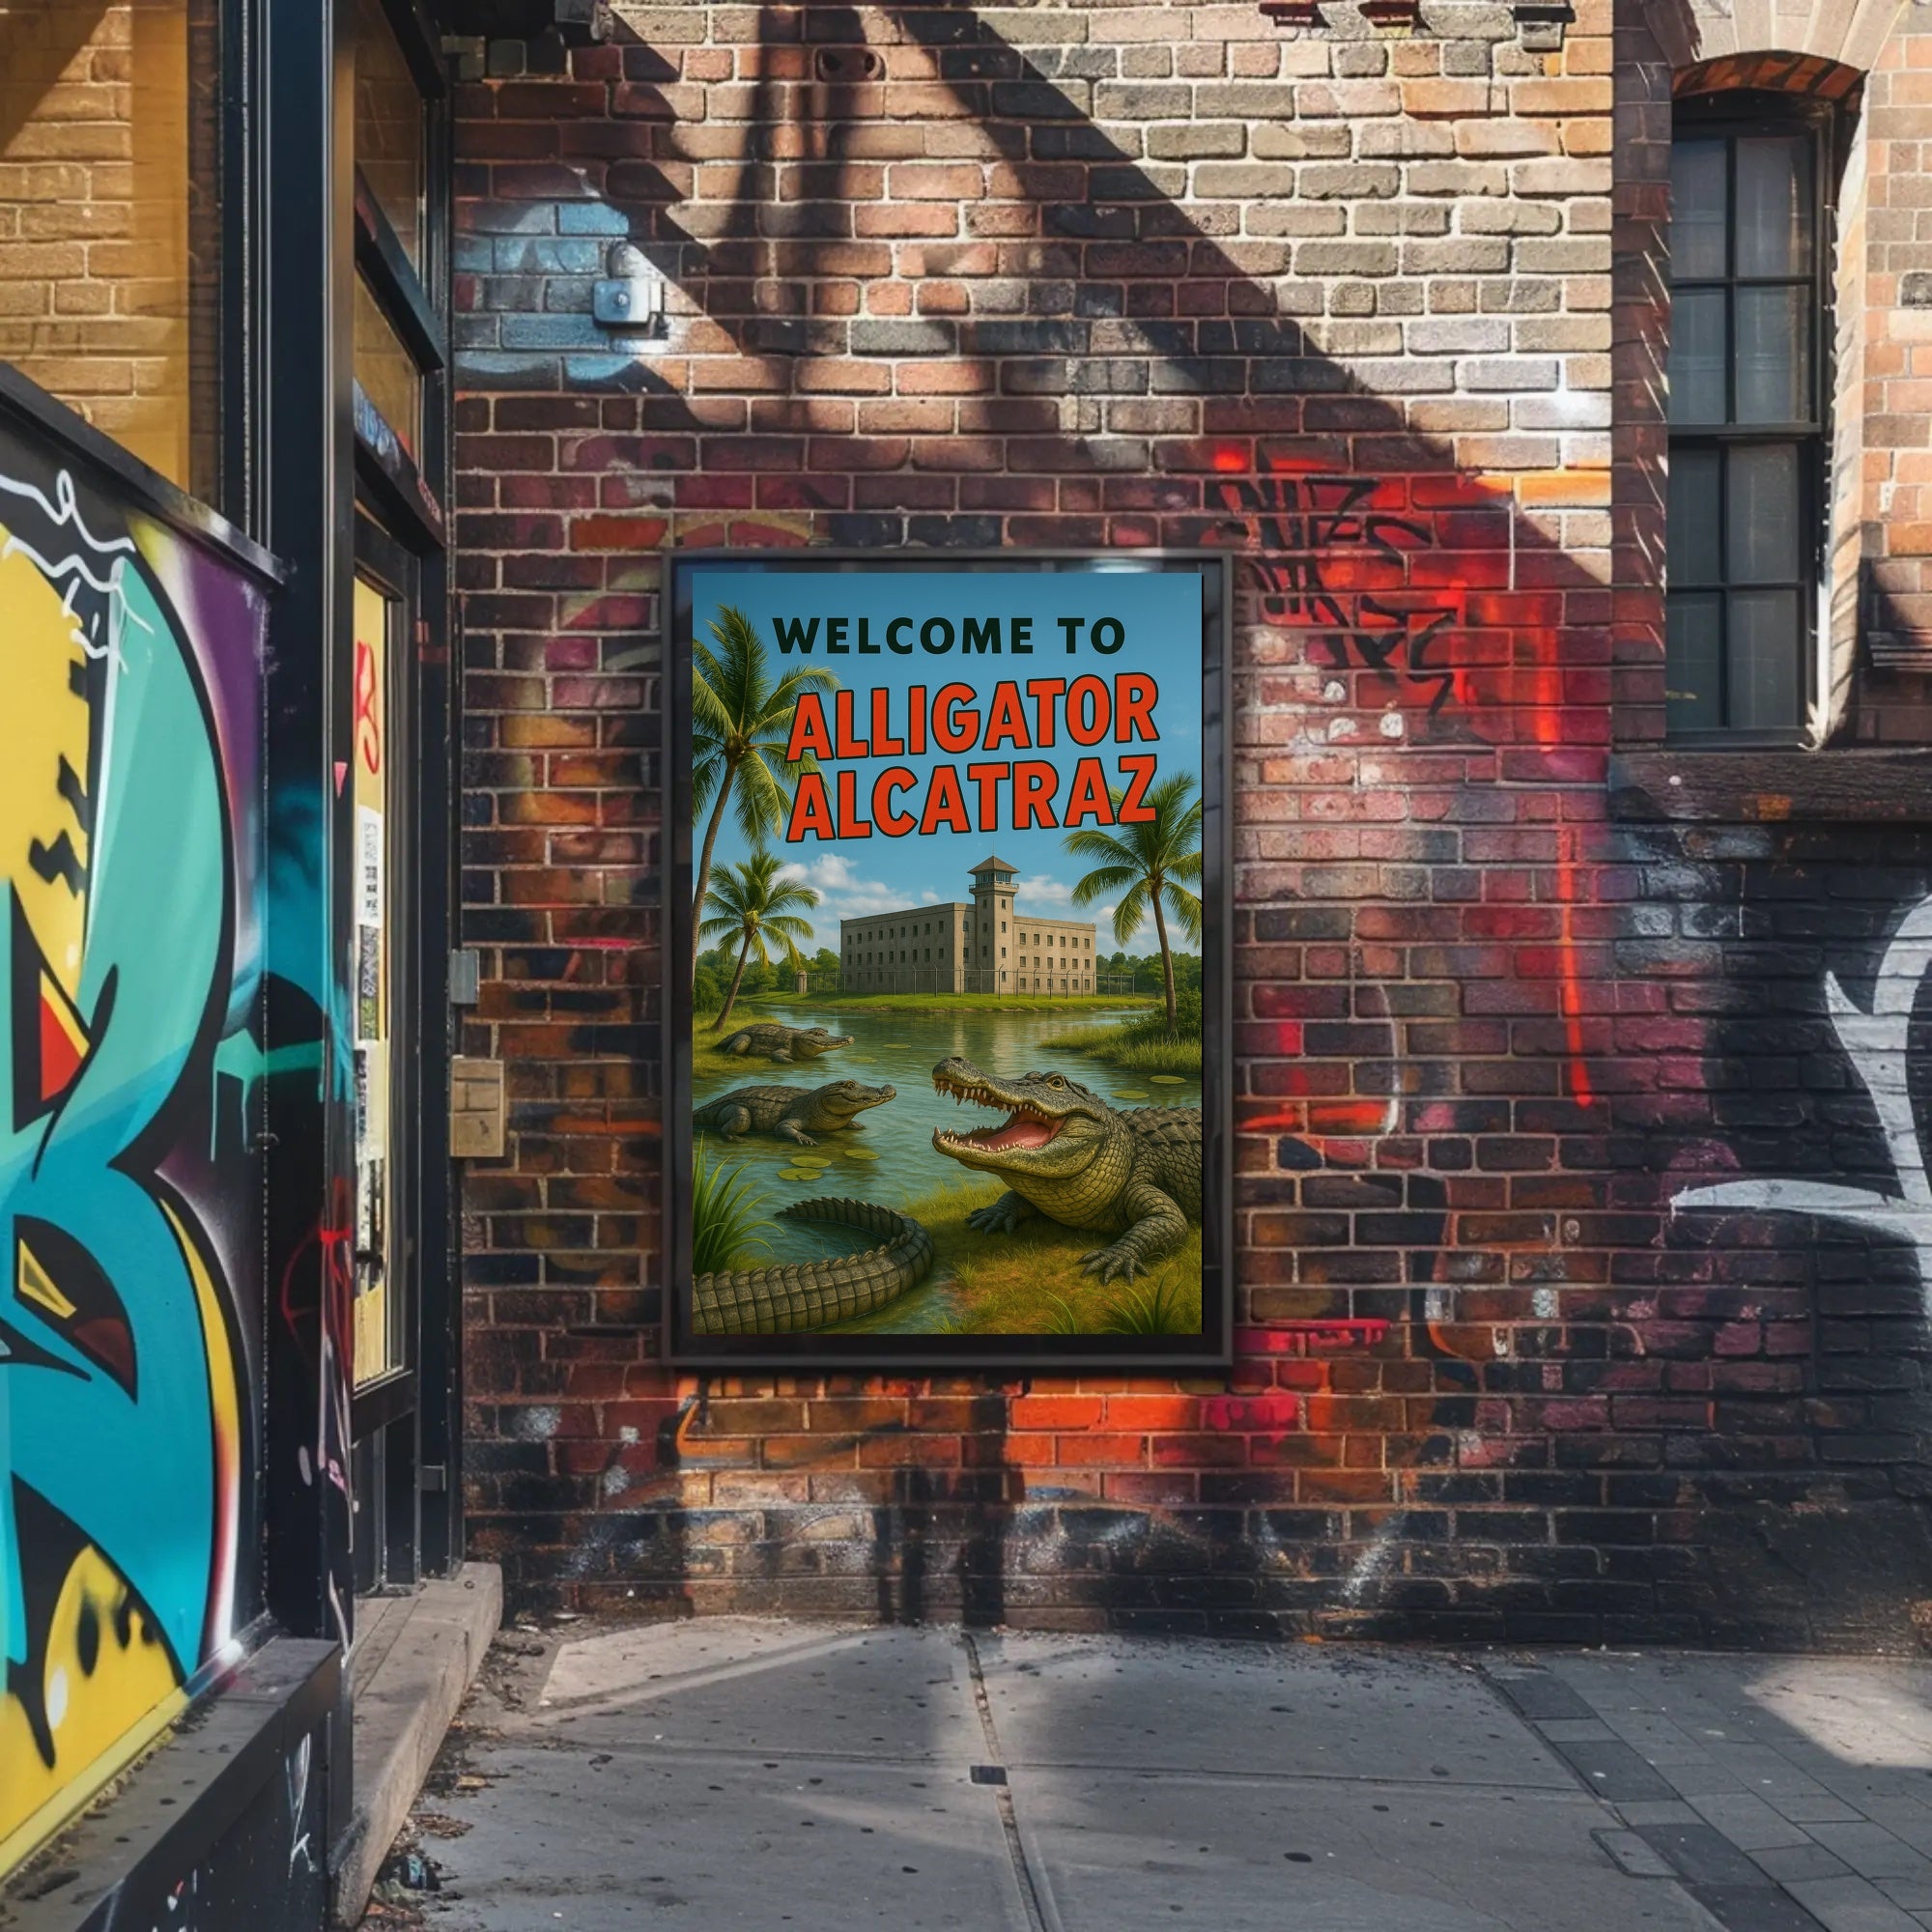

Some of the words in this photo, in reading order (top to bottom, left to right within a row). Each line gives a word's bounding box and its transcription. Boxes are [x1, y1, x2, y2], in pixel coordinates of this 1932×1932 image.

[773, 617, 1033, 654] WELCOME
[1058, 617, 1125, 654] TO
[786, 672, 1160, 762] ALLIGATOR
[786, 753, 1158, 842] ALCATRAZ
